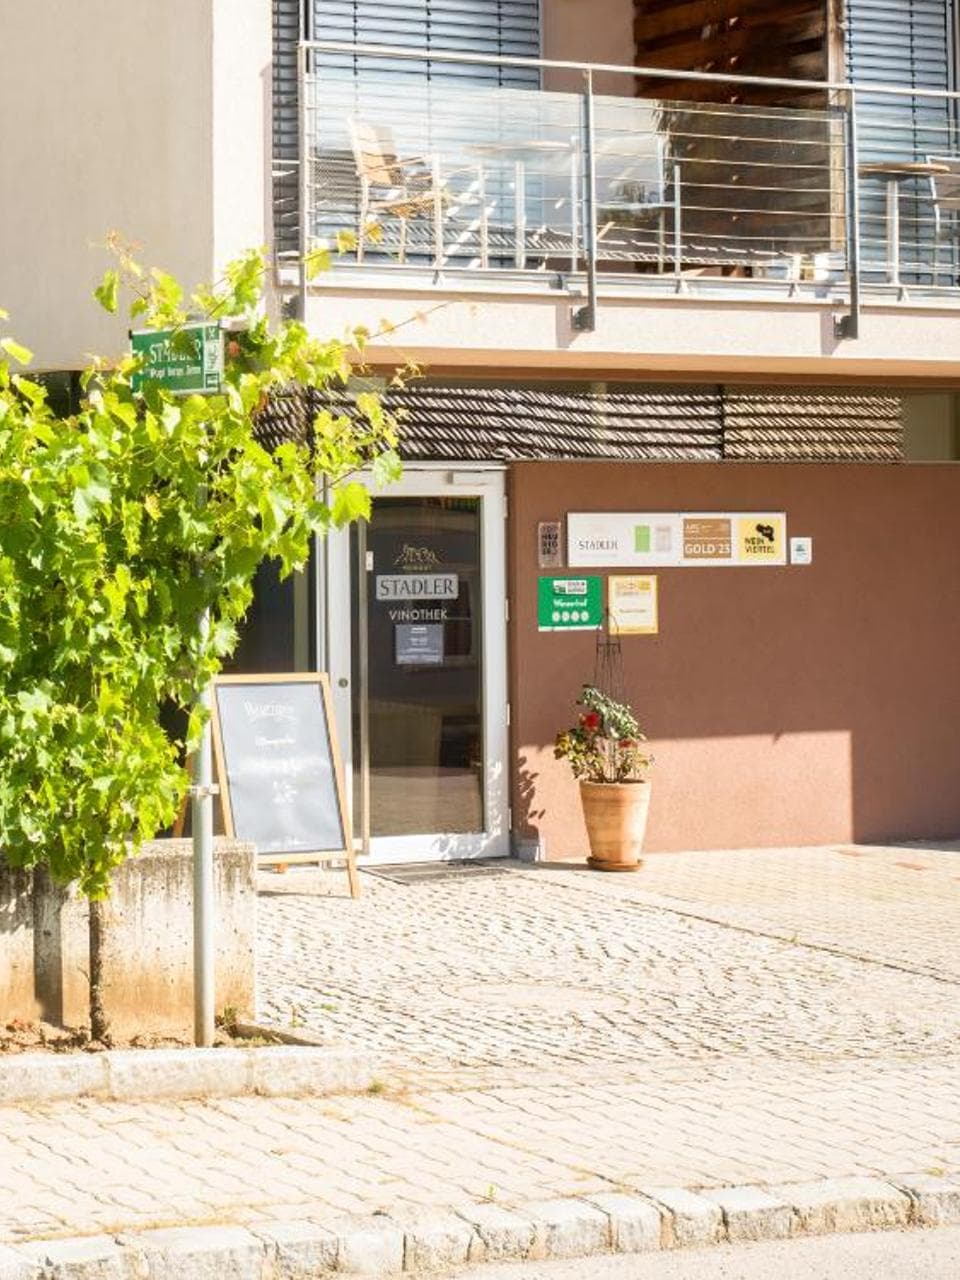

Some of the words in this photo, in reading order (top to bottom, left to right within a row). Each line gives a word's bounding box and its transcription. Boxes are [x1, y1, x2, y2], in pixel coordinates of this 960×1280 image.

[685, 543, 716, 554] GOLD
[744, 545, 775, 554] VIERTEL
[380, 577, 454, 597] STADLER
[389, 608, 448, 621] VINOTHEK
